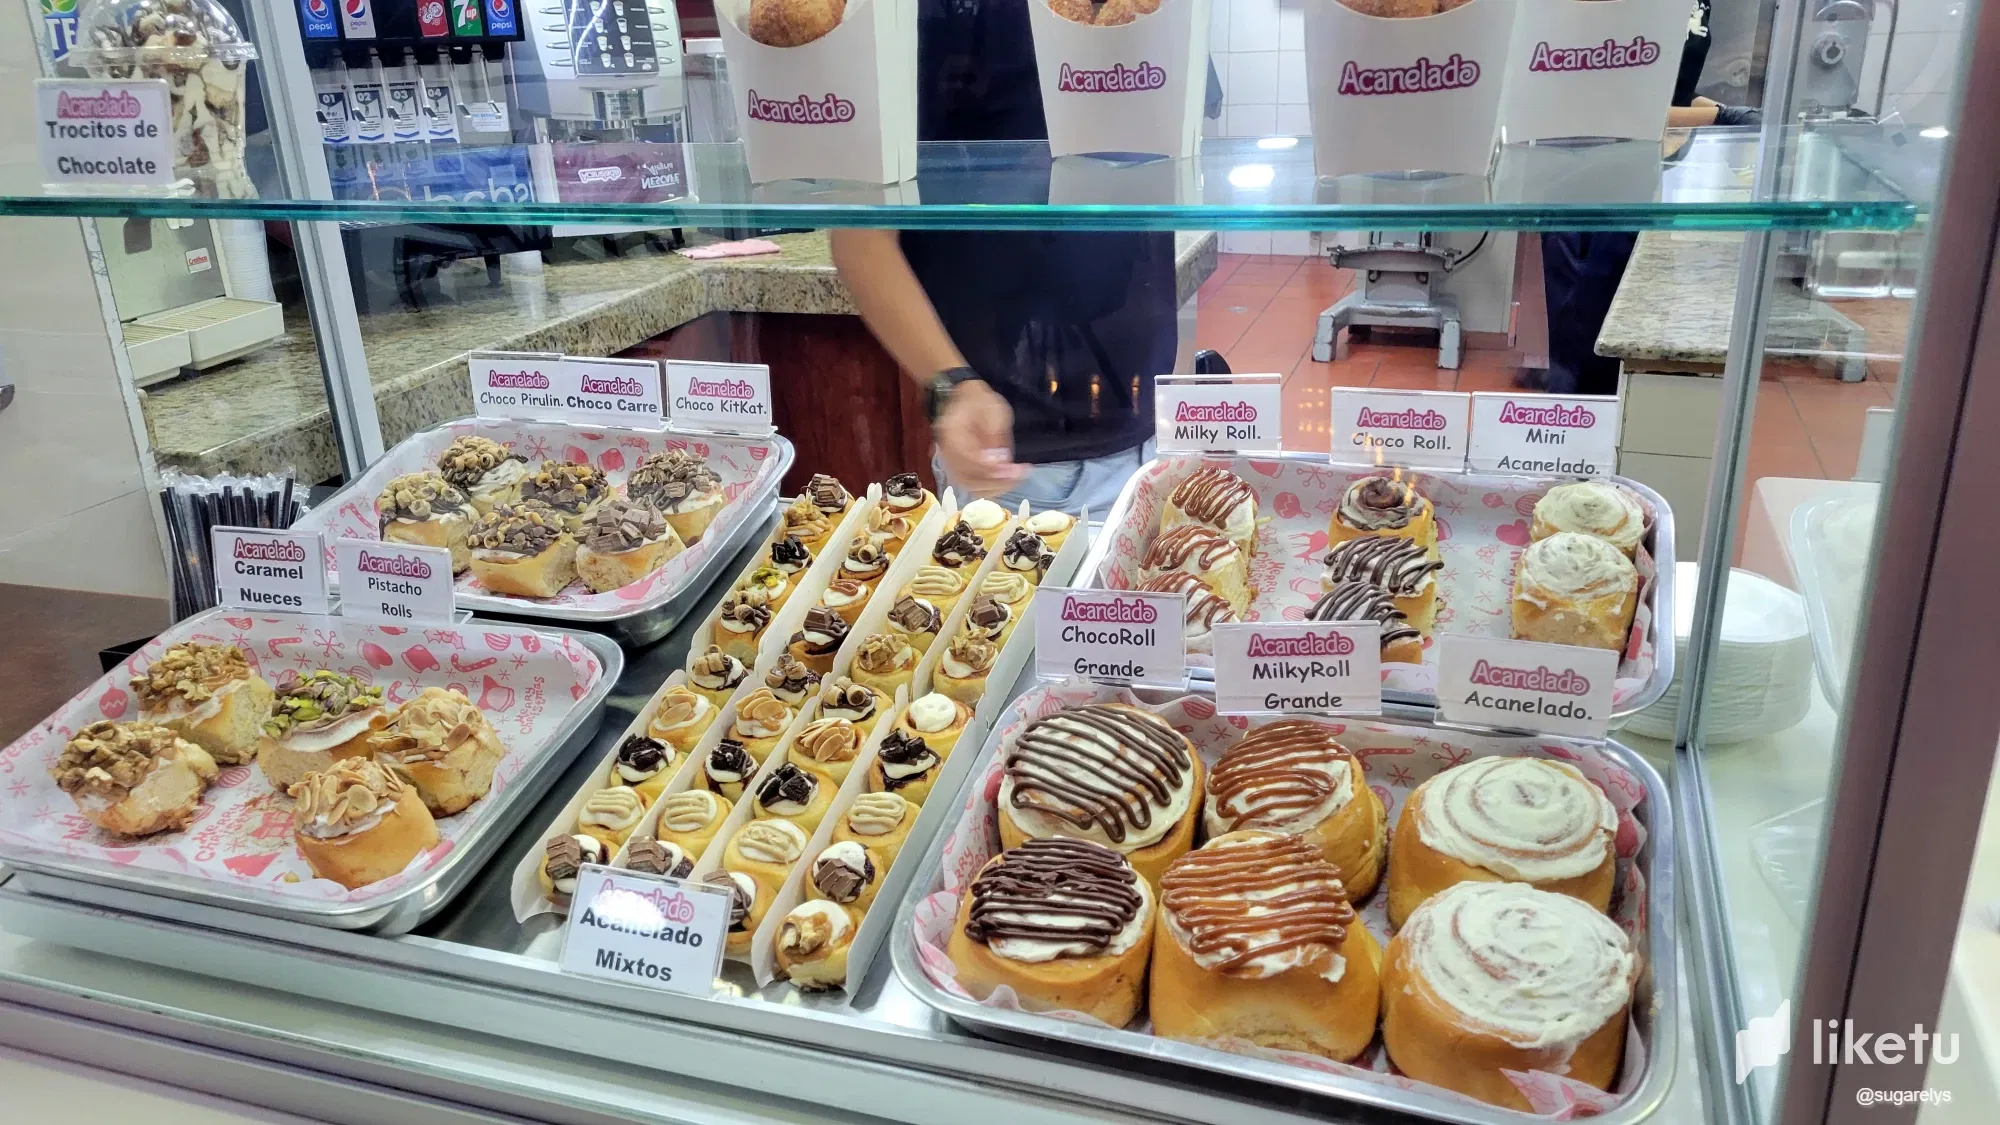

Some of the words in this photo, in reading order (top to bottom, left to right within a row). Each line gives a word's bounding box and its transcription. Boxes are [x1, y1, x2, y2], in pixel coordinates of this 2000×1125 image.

[308, 22, 333, 32] pepsi
[491, 21, 512, 31] pepsi
[1529, 35, 1660, 72] Acanelado
[1058, 61, 1166, 92] Acanelado
[1338, 53, 1480, 95] Acanelado
[322, 94, 336, 104] 01
[357, 92, 372, 102] 02
[393, 90, 408, 99] 03
[428, 88, 442, 98] 04
[57, 90, 141, 118] Acanelado
[748, 89, 855, 124] Acanelado
[46, 121, 127, 138] Trocitos
[135, 120, 158, 138] de
[57, 156, 157, 174] Chocolate
[489, 369, 549, 389] Acanelado
[580, 375, 644, 396] Acanelado
[689, 377, 754, 399] Acanelado
[480, 392, 516, 406] Choco
[521, 393, 564, 407] Pirulin.
[566, 396, 613, 411] Choco
[617, 399, 658, 413] Carre
[676, 397, 714, 412] Choco
[720, 400, 768, 415] KitKat.
[1175, 401, 1257, 422] Acanelado
[1357, 407, 1446, 430] Acanelado
[1499, 401, 1596, 428] Acanelado
[1175, 425, 1221, 444] Milky
[1226, 425, 1262, 441] Roll.
[1352, 432, 1406, 449] Choco
[1413, 434, 1452, 450] Roll.
[1525, 428, 1566, 446] Mini
[1497, 456, 1601, 476] Acanelado.
[233, 537, 305, 562] Acanelado
[234, 561, 304, 580] Caramel
[358, 551, 431, 579] Acanelado
[240, 587, 303, 606] Nueces
[368, 577, 422, 596] Pistacho
[381, 602, 413, 618] Rolls
[1061, 596, 1157, 623] Acanelado
[1061, 625, 1155, 647] ChocoRoll
[1247, 631, 1354, 657] Acanelado
[1073, 658, 1145, 678] Grande
[1252, 659, 1350, 684] MilkyRoll
[1470, 659, 1589, 696] Acanelado
[1264, 691, 1343, 710] Grande
[1464, 690, 1593, 721] Acanelado.
[595, 948, 673, 982] Mixtos
